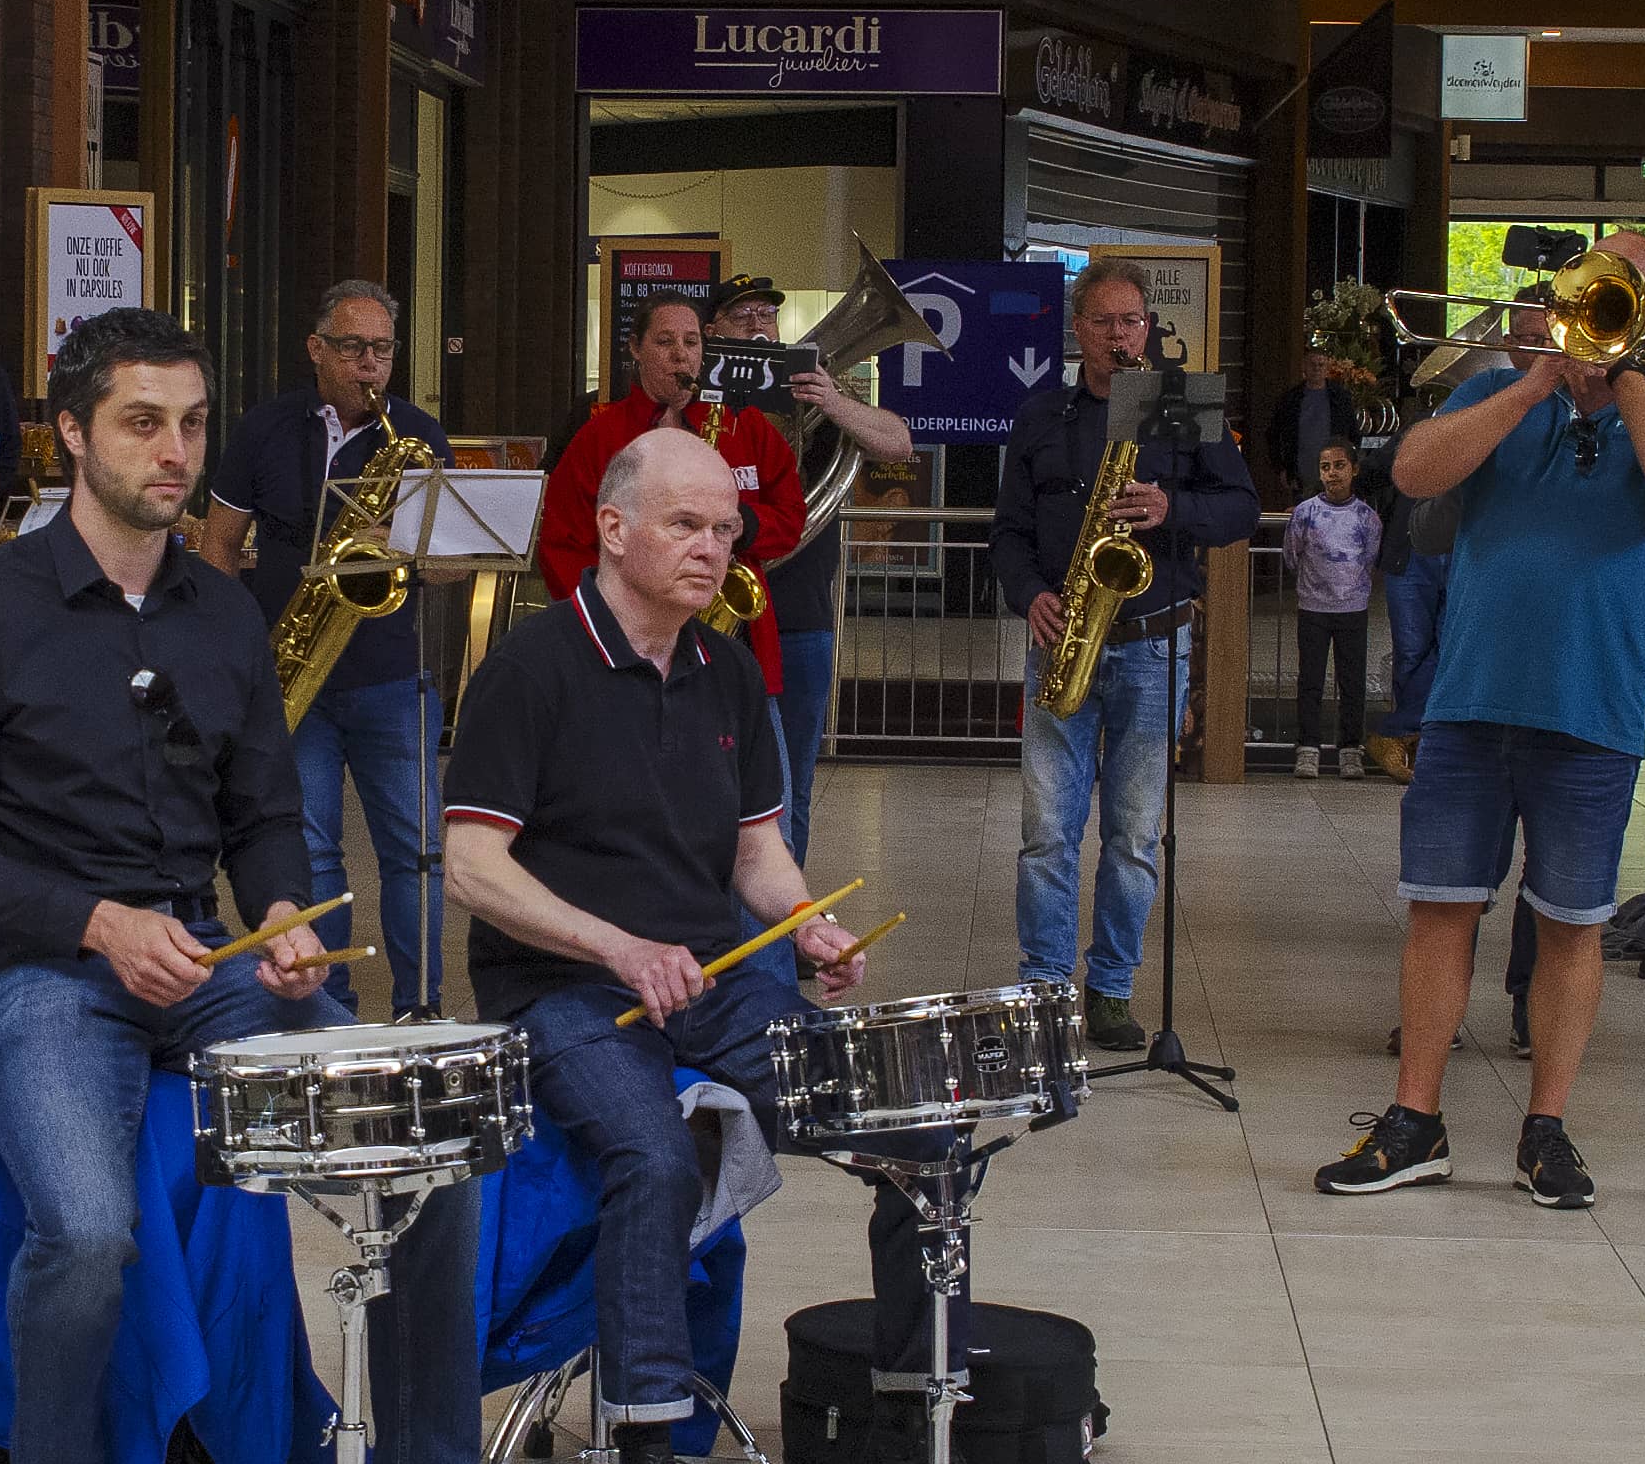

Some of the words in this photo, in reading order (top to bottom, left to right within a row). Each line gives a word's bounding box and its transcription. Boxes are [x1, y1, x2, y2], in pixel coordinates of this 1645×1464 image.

[693, 14, 882, 55] Lucardi
[768, 46, 868, 88] juwelier
[66, 236, 91, 256] ONZE
[94, 237, 123, 257] KOFFIE
[76, 258, 89, 277] NU
[93, 258, 111, 278] OOK
[623, 263, 673, 276] KOFFIEBONEN
[1155, 269, 1181, 286] ALLE
[66, 278, 76, 298] IN
[80, 279, 123, 299] CAPSULES
[637, 283, 648, 297] 88
